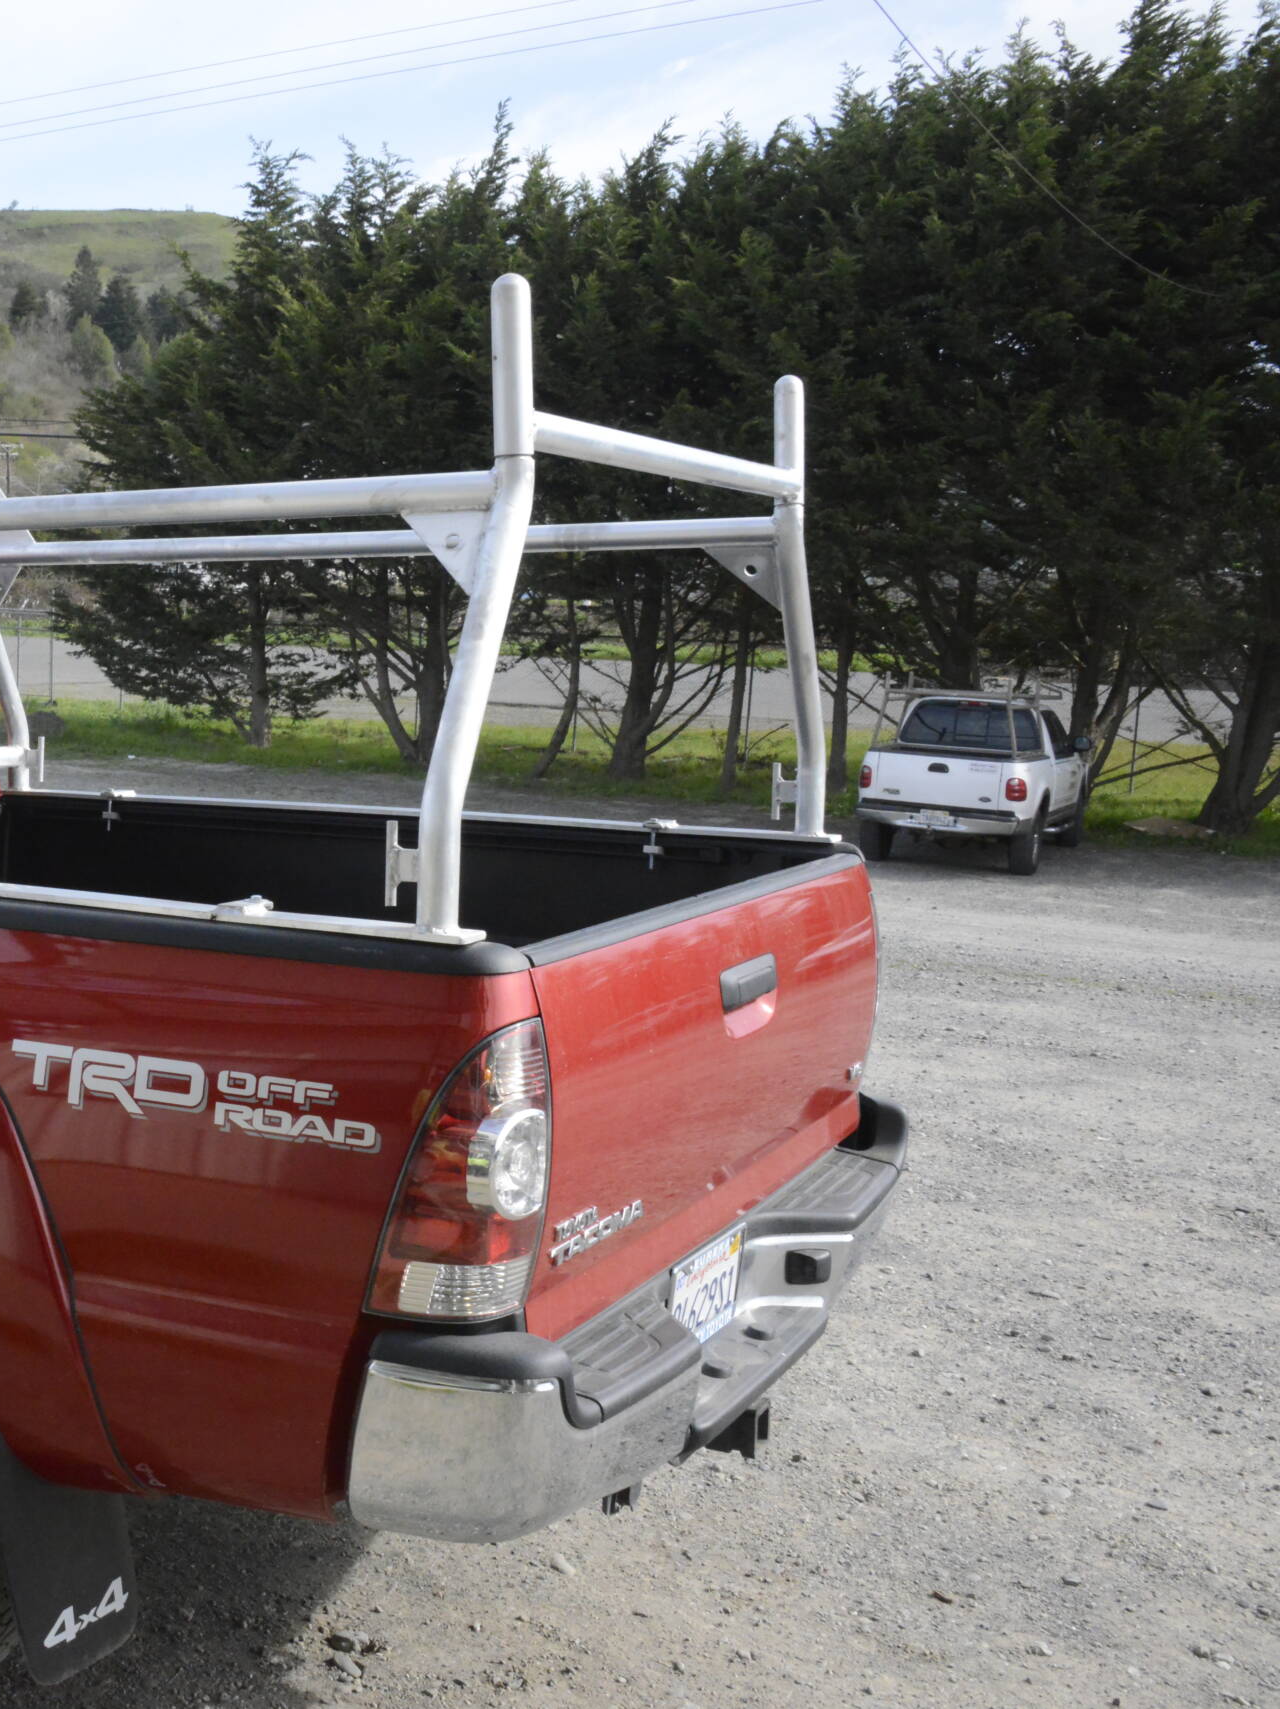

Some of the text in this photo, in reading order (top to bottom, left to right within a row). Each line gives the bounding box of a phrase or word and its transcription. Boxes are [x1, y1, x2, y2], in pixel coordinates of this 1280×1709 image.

[11, 1038, 209, 1120] TRD
[216, 1069, 339, 1110] OFF
[213, 1101, 382, 1155] ROAD
[550, 1200, 644, 1267] TACOMA
[43, 1576, 129, 1649] 4x4
